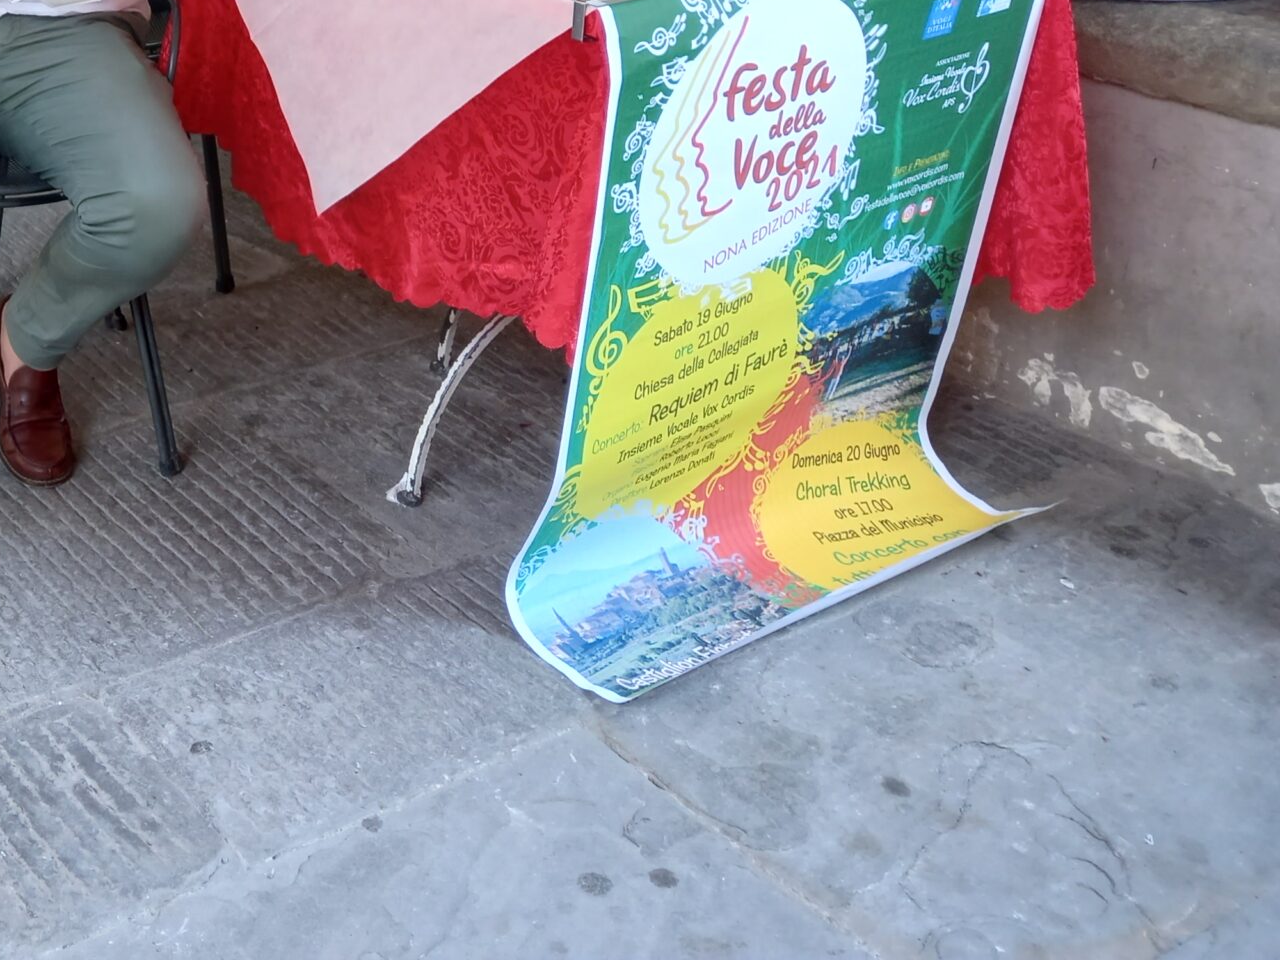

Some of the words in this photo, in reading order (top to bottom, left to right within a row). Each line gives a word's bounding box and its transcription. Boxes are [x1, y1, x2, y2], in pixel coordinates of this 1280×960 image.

[903, 89, 926, 108] Vox
[926, 78, 961, 101] Cordis
[769, 101, 826, 140] della
[734, 130, 819, 190] Voce
[766, 144, 838, 212] 2021
[703, 239, 748, 273] NONA
[751, 198, 813, 246] EDIZIONE
[653, 319, 693, 347] Sabato
[696, 308, 711, 328] 19
[714, 293, 753, 320] Giugno
[675, 343, 694, 360] ore
[697, 322, 730, 350] 21.00
[634, 374, 674, 401] Chiesa
[678, 358, 704, 381] della
[707, 329, 759, 365] Collegiata
[648, 378, 719, 426] Requiem
[723, 364, 740, 387] di
[743, 338, 789, 377] Faurè
[617, 432, 663, 464] Insieme
[667, 412, 699, 438] Vocale
[702, 402, 719, 419] Vox
[720, 383, 756, 409] Cordis
[634, 462, 672, 485] Eugenio
[673, 448, 699, 467] Maria
[648, 467, 686, 491] Lorenzo
[687, 451, 716, 472] Donati
[792, 450, 843, 470] Domenica
[846, 445, 861, 462] 20
[864, 442, 901, 462] Giugno
[796, 476, 842, 501] Choral
[845, 471, 911, 494] Trekking
[834, 506, 858, 520] ore
[855, 498, 894, 517] 17.00
[812, 527, 860, 545] Piazza
[860, 522, 881, 538] del
[880, 513, 944, 534] Municipio
[832, 538, 929, 566] Concerto
[932, 528, 971, 543] con
[615, 659, 702, 690] Castiglion
